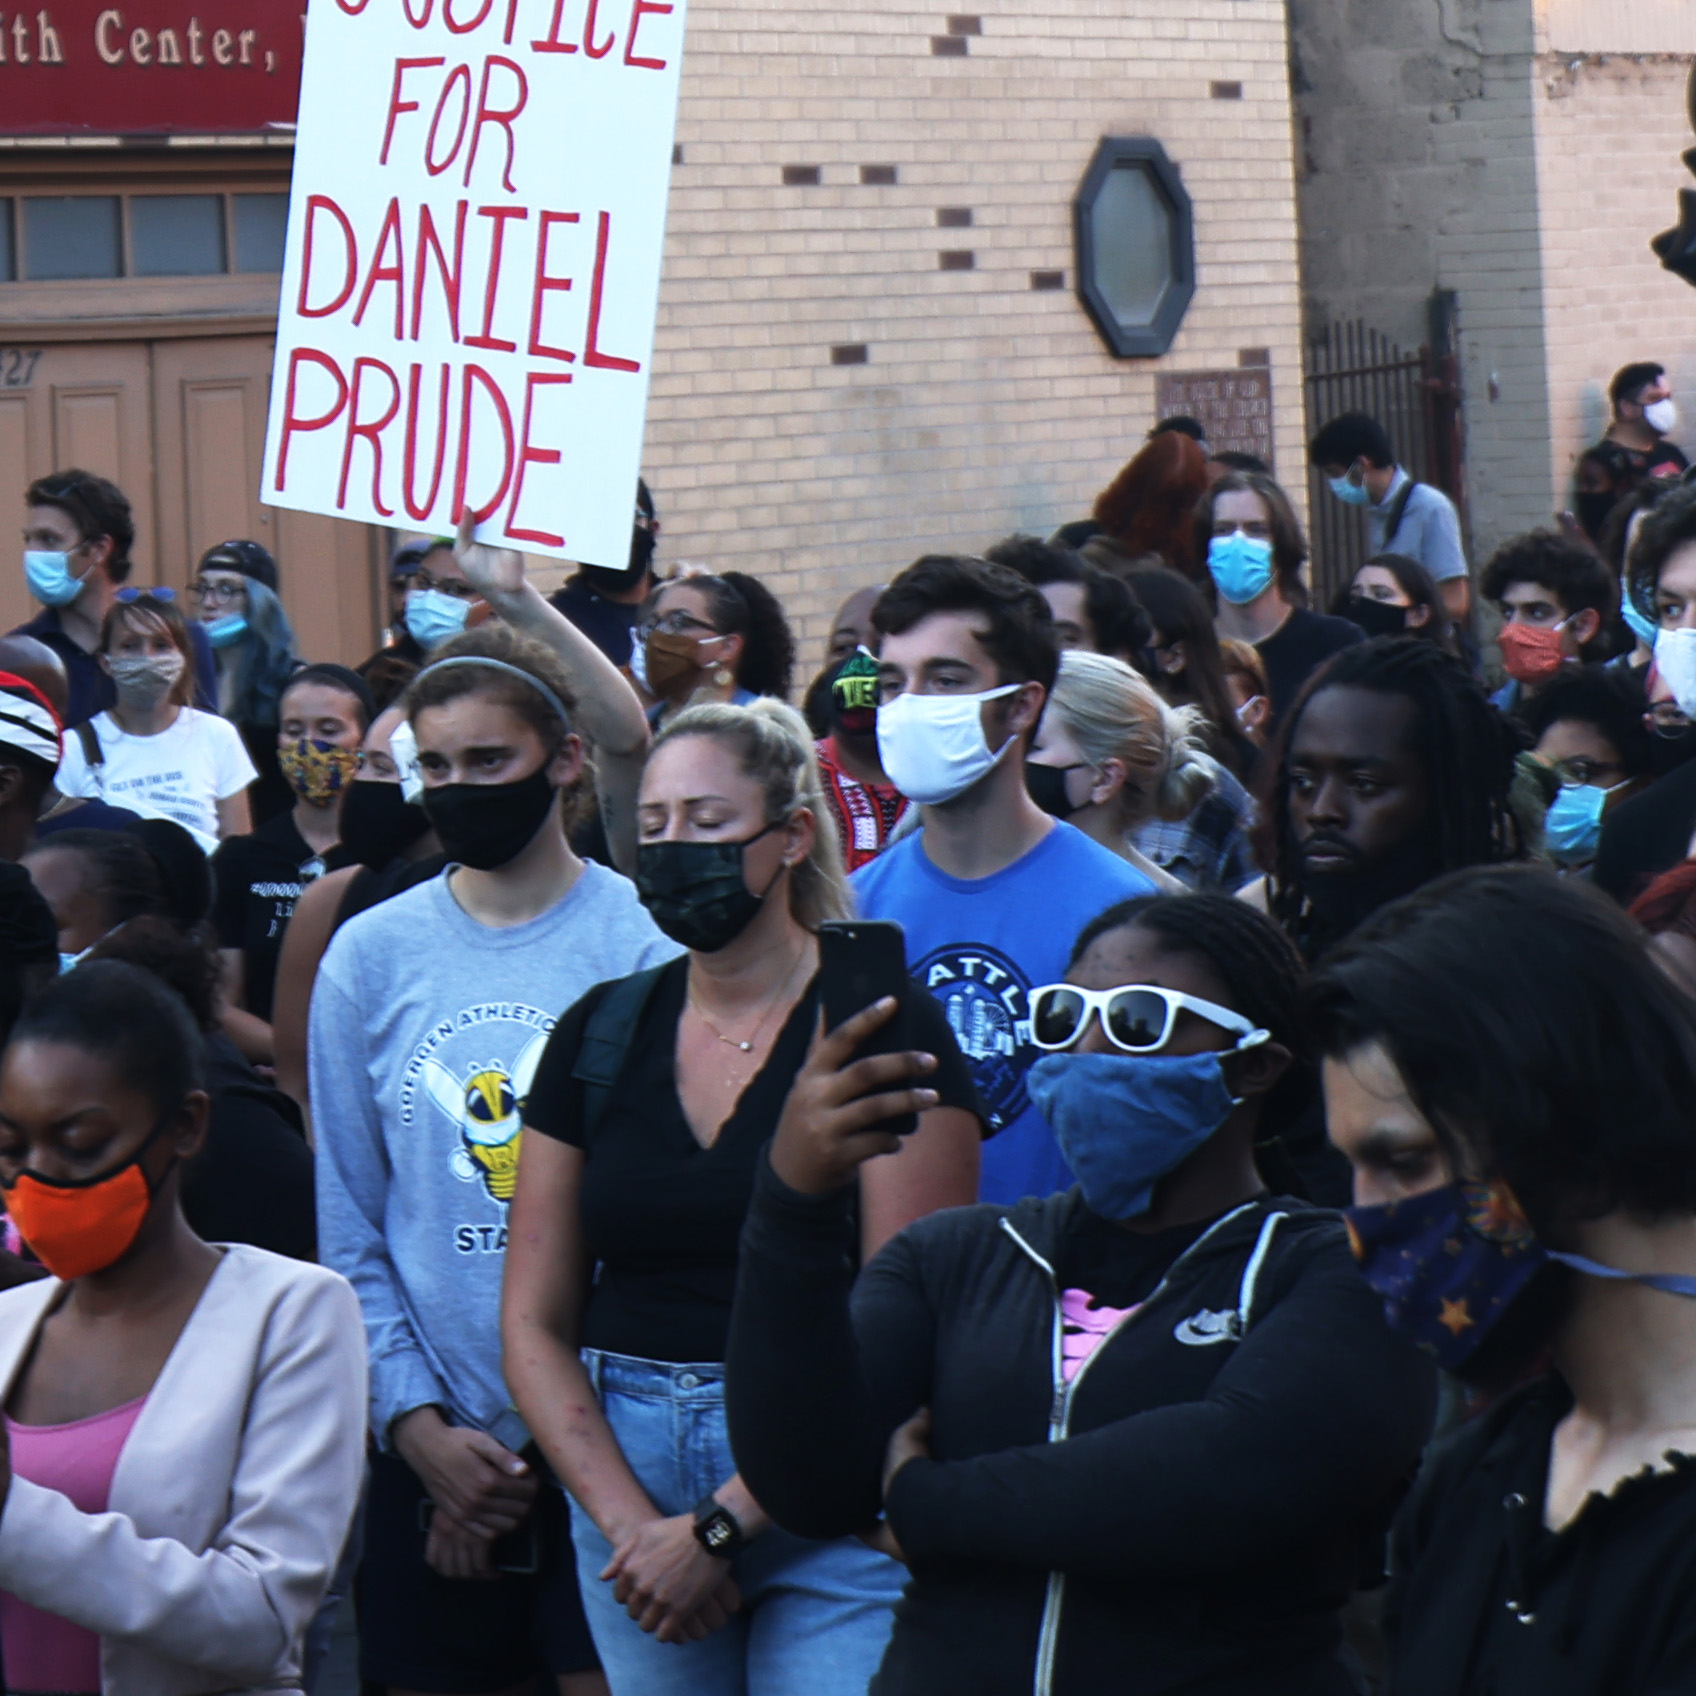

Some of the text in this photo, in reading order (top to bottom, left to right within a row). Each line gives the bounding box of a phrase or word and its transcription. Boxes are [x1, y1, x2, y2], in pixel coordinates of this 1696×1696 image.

[94, 7, 278, 72] Center,
[379, 55, 529, 193] FOR
[296, 195, 641, 373] DANIEL
[274, 346, 574, 547] PRUDE
[926, 956, 1032, 1047] ATTLE
